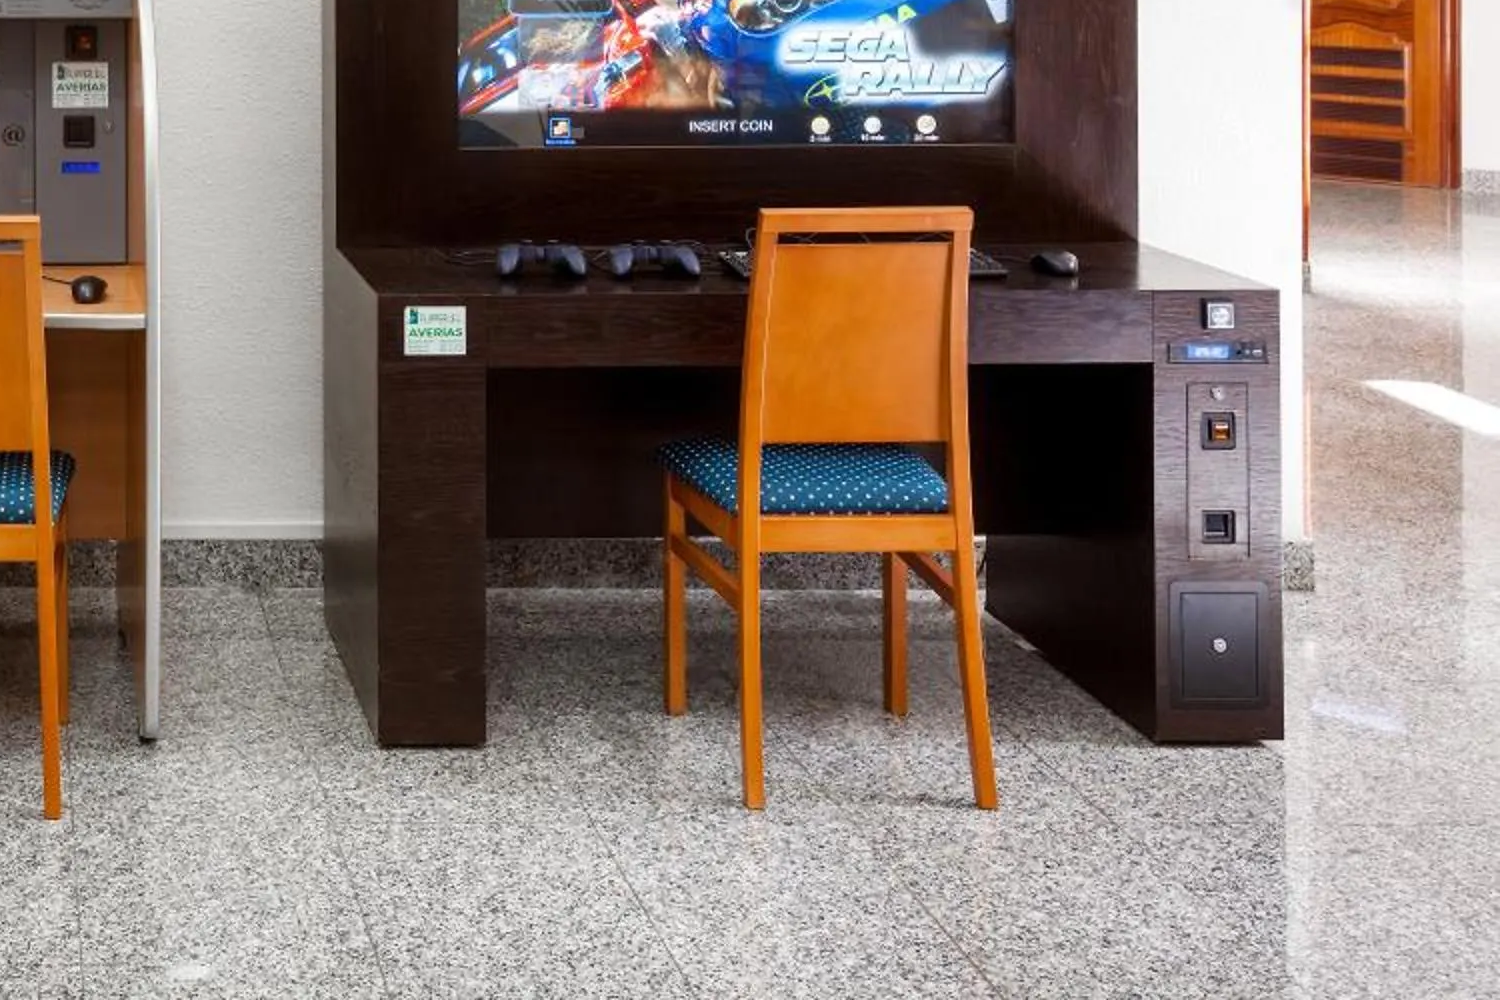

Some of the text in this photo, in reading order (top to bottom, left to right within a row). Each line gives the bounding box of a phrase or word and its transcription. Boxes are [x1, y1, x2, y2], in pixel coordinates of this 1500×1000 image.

[784, 27, 911, 63] SEGA
[843, 59, 1008, 97] RALLY
[688, 119, 774, 133] INSERT COIN
